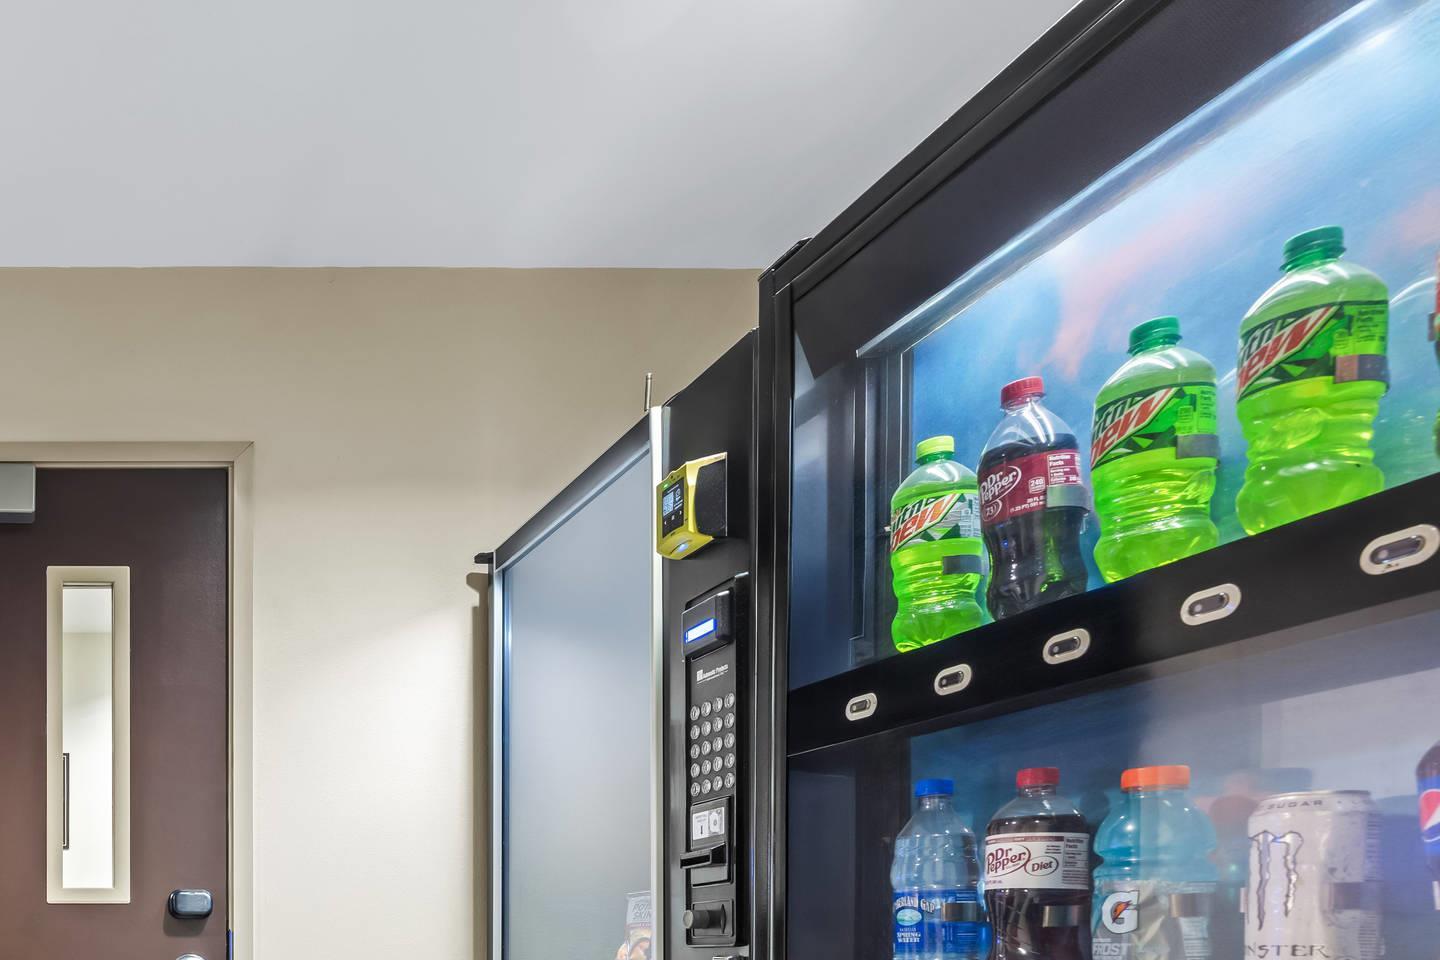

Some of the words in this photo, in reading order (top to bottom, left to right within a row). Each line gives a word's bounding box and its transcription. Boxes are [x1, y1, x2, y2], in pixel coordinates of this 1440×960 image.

[980, 471, 1017, 505] Pepper
[987, 471, 1003, 489] Dr
[987, 852, 1026, 875] Pepper
[995, 848, 1012, 861] Dr
[1031, 861, 1053, 872] Diet
